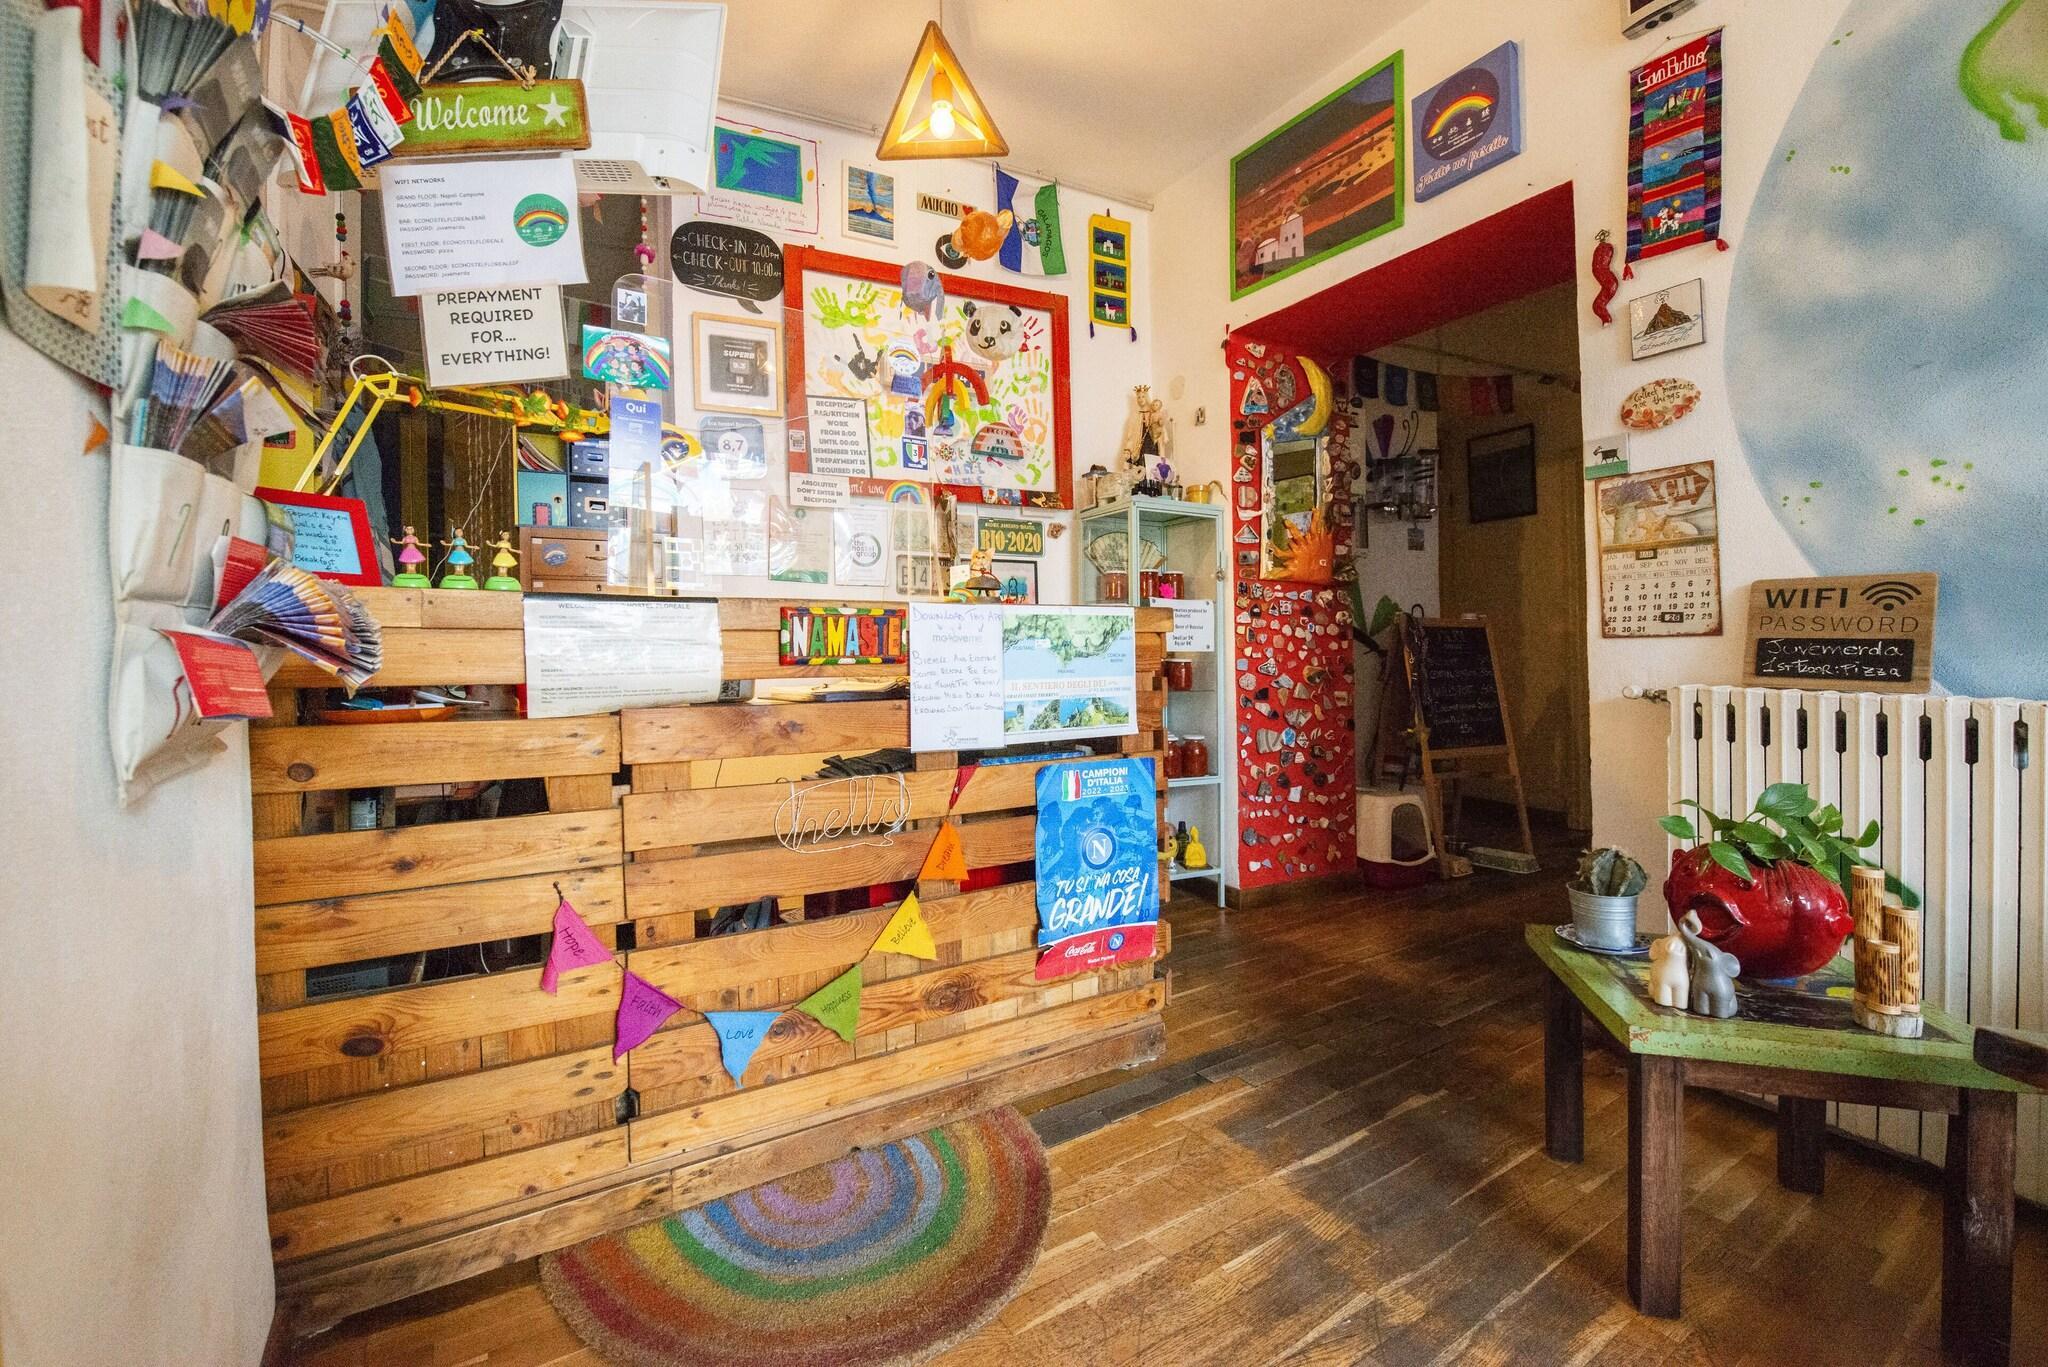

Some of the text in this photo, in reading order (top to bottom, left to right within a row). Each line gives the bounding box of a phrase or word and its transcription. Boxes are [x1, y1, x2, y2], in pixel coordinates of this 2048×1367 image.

[1637, 66, 1666, 92] San
[410, 95, 530, 131] Welcome
[411, 177, 446, 185] NETWORKS
[921, 195, 958, 217] MUCHO
[687, 232, 747, 255] CHECK-IN
[682, 251, 749, 274] CHECK-OUT
[707, 274, 747, 292] Thanks!
[437, 287, 542, 306] PREPAYMENT
[450, 309, 534, 325] REQUIRED
[471, 329, 517, 344] FOR...
[441, 347, 550, 366] EVERYTHING!
[723, 349, 755, 360] SUPERB
[1633, 381, 1695, 402] Collect moments
[1652, 391, 1681, 406] things
[625, 402, 647, 414] Qui
[722, 439, 744, 452] 8,7
[813, 448, 849, 456] REMEMBER
[912, 449, 919, 457] 3
[815, 457, 859, 466] PREPAYMENT
[801, 480, 838, 488] ABSOLUTELY
[980, 529, 1042, 553] RIO-2020
[856, 551, 877, 560] group
[1695, 556, 1709, 564] DEC
[1684, 591, 1694, 599] 13
[1700, 590, 1710, 598] 14
[1765, 587, 1848, 609] WIFI
[1637, 604, 1647, 612] 17
[1652, 603, 1662, 611] 18
[1668, 602, 1678, 610] 19
[1683, 602, 1694, 610] 20
[1700, 601, 1710, 609] 21
[1622, 615, 1632, 623] 23
[1668, 613, 1680, 621] 26
[1684, 613, 1695, 621] 27
[1759, 615, 1919, 633] PASSWORD
[792, 615, 901, 657] NAMASTE
[1636, 625, 1646, 633] 31
[1022, 680, 1064, 691] SENTIERO
[1067, 680, 1090, 689] DEGLI
[1092, 679, 1107, 688] DEI
[1082, 767, 1128, 779] CAMPIONI
[1087, 777, 1123, 787] D'ITALIA
[1082, 788, 1102, 796] 2022
[1110, 785, 1128, 793] 2023
[785, 777, 903, 850] hello
[1091, 838, 1107, 859] N
[1056, 880, 1075, 897] TU
[1113, 866, 1140, 885] COSA
[1049, 873, 1149, 931] GRANDE!
[558, 926, 585, 958] Hope
[630, 995, 663, 1018] Faith
[726, 1027, 755, 1041] Love
